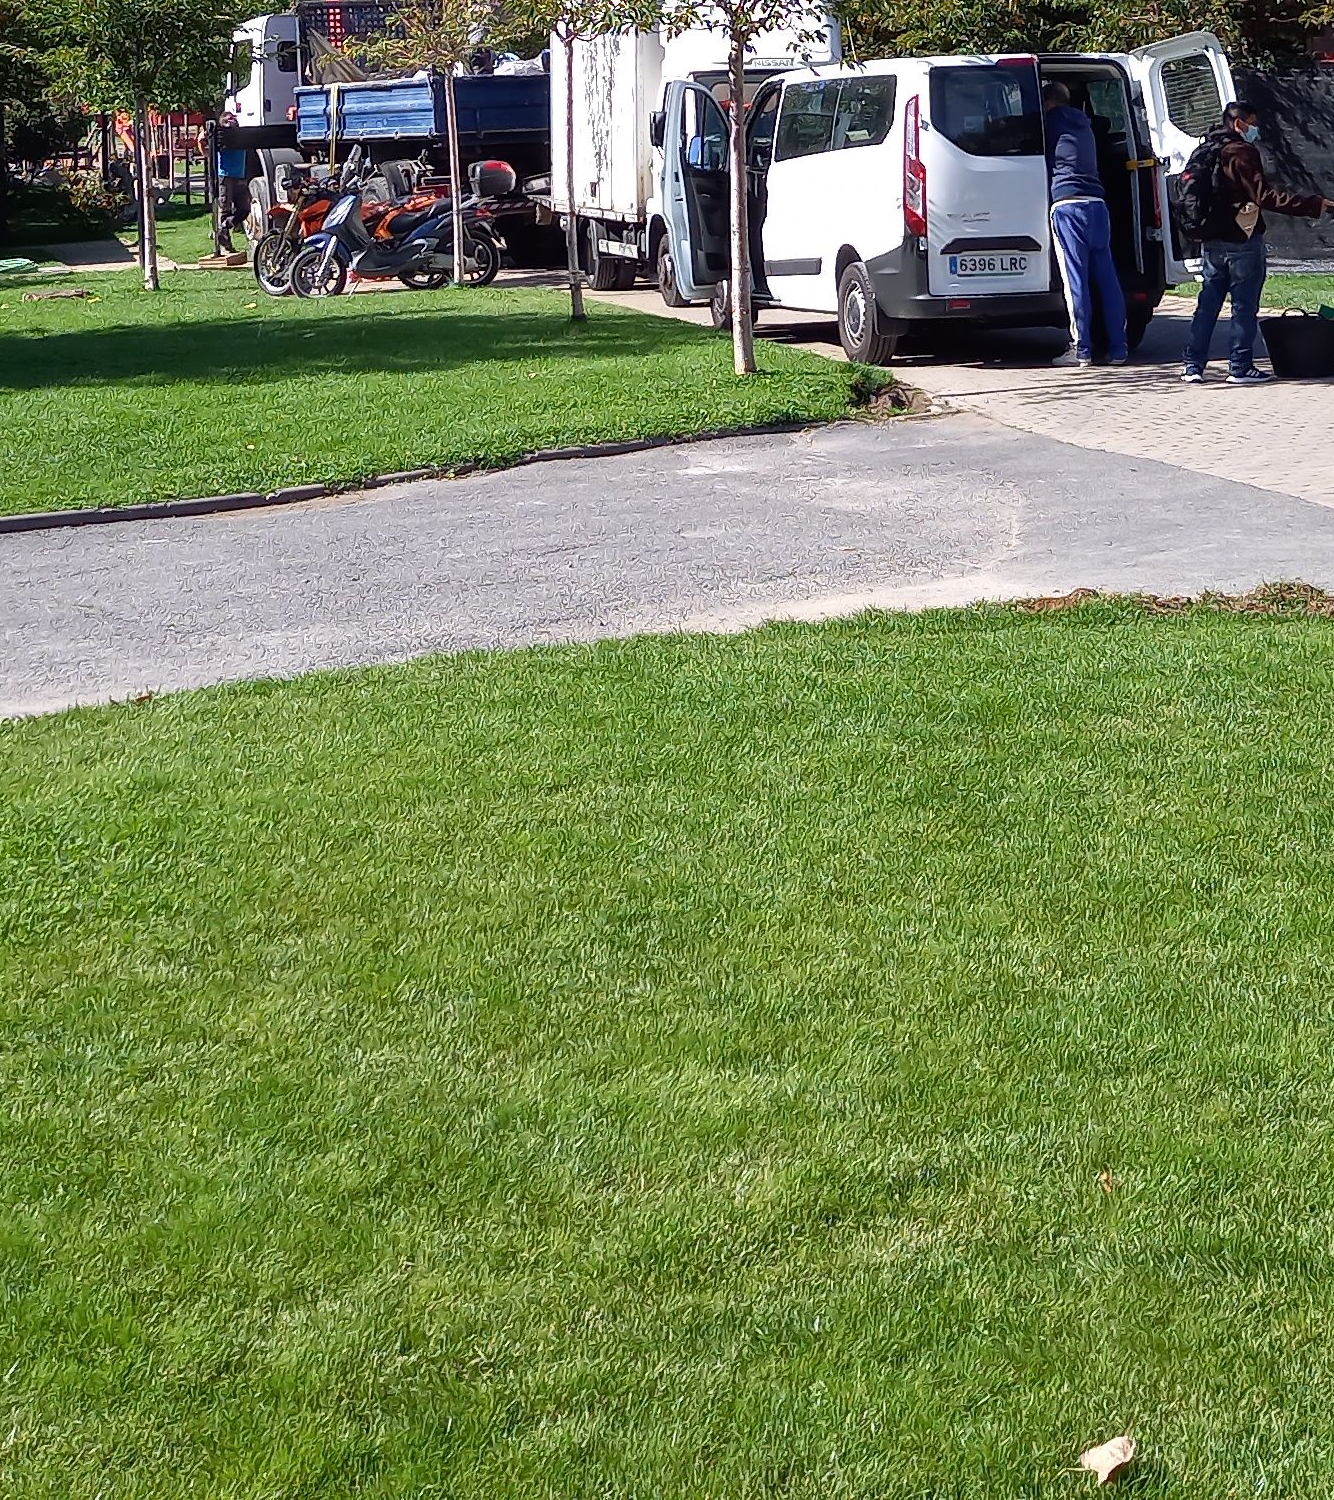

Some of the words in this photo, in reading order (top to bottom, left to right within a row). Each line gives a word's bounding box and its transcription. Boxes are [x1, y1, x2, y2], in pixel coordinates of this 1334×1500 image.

[754, 59, 794, 67] NISSAN
[959, 257, 996, 272] 6396
[1000, 256, 1028, 271] LRC
